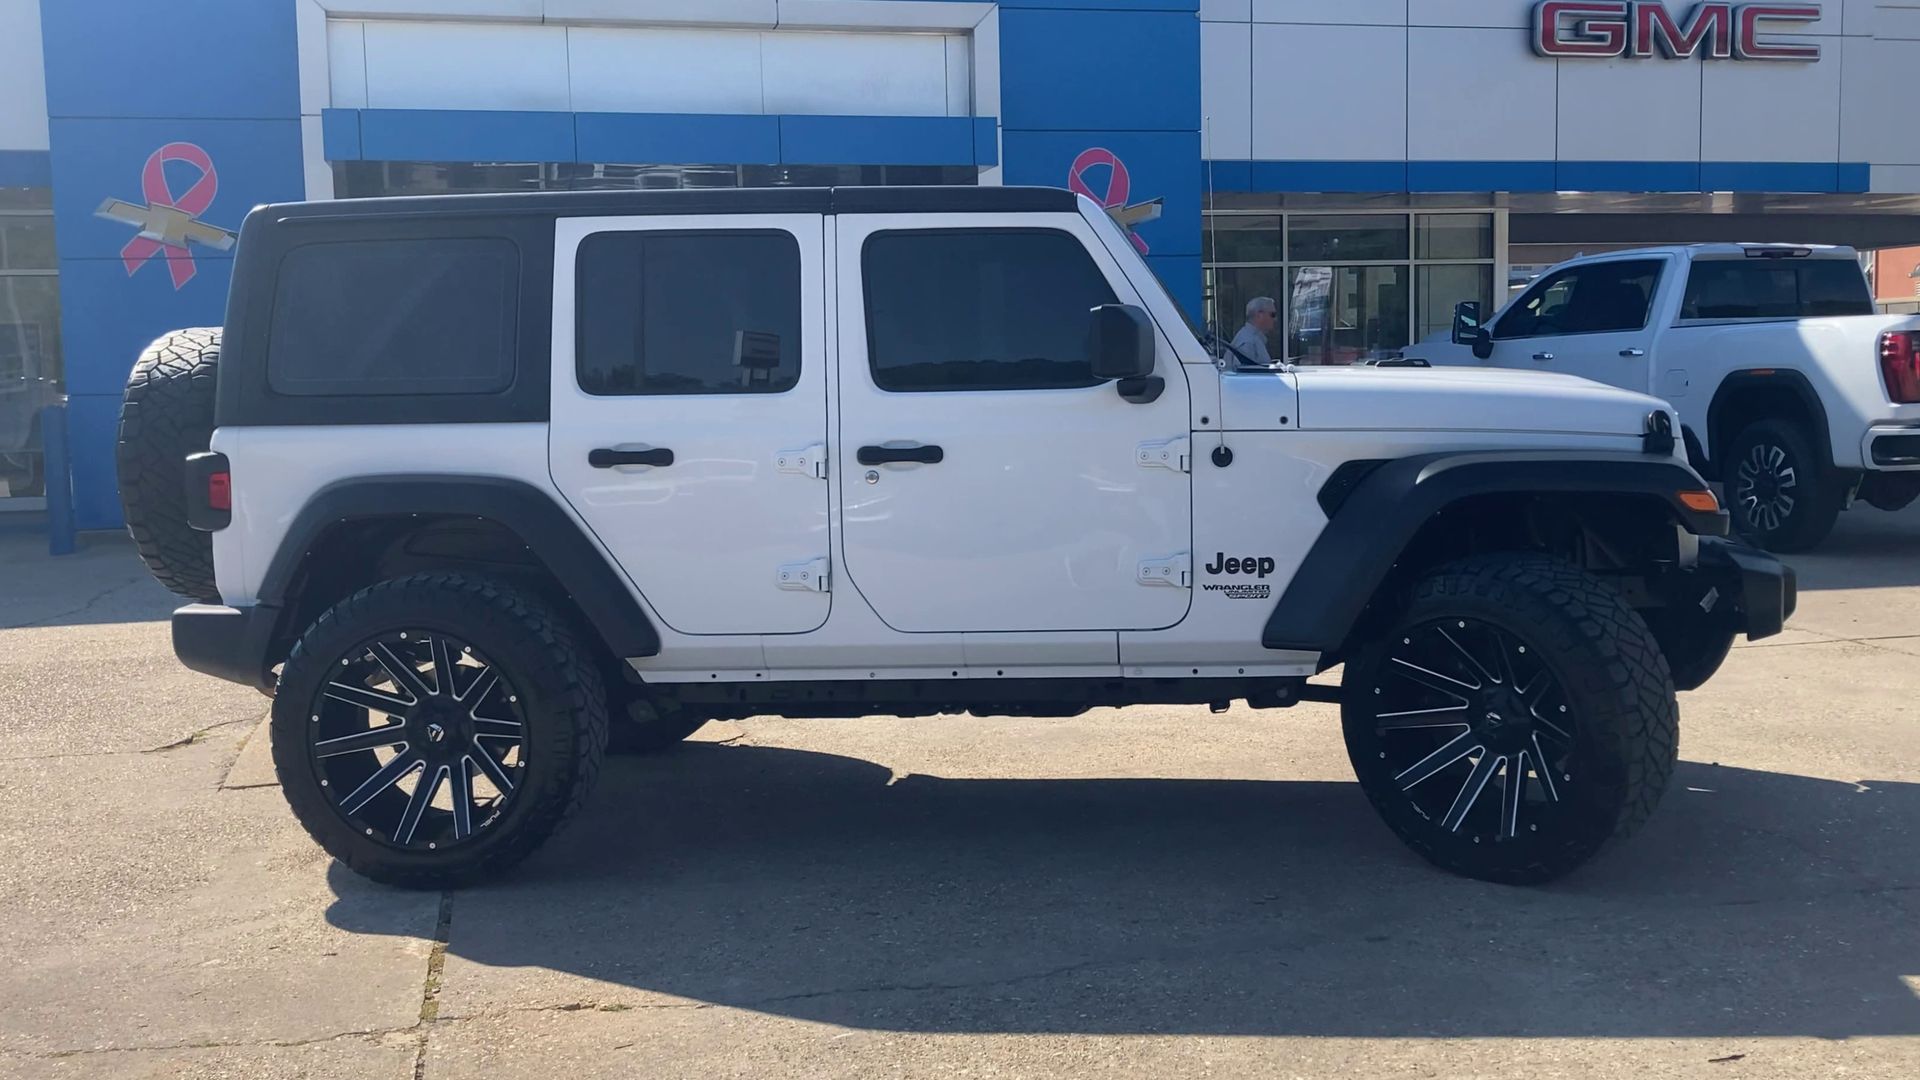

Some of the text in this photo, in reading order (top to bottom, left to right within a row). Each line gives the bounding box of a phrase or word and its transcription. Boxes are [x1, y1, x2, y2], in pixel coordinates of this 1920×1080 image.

[1531, 1, 1821, 61] GMC
[1205, 552, 1275, 578] Jeep
[480, 810, 501, 828] FUEL
